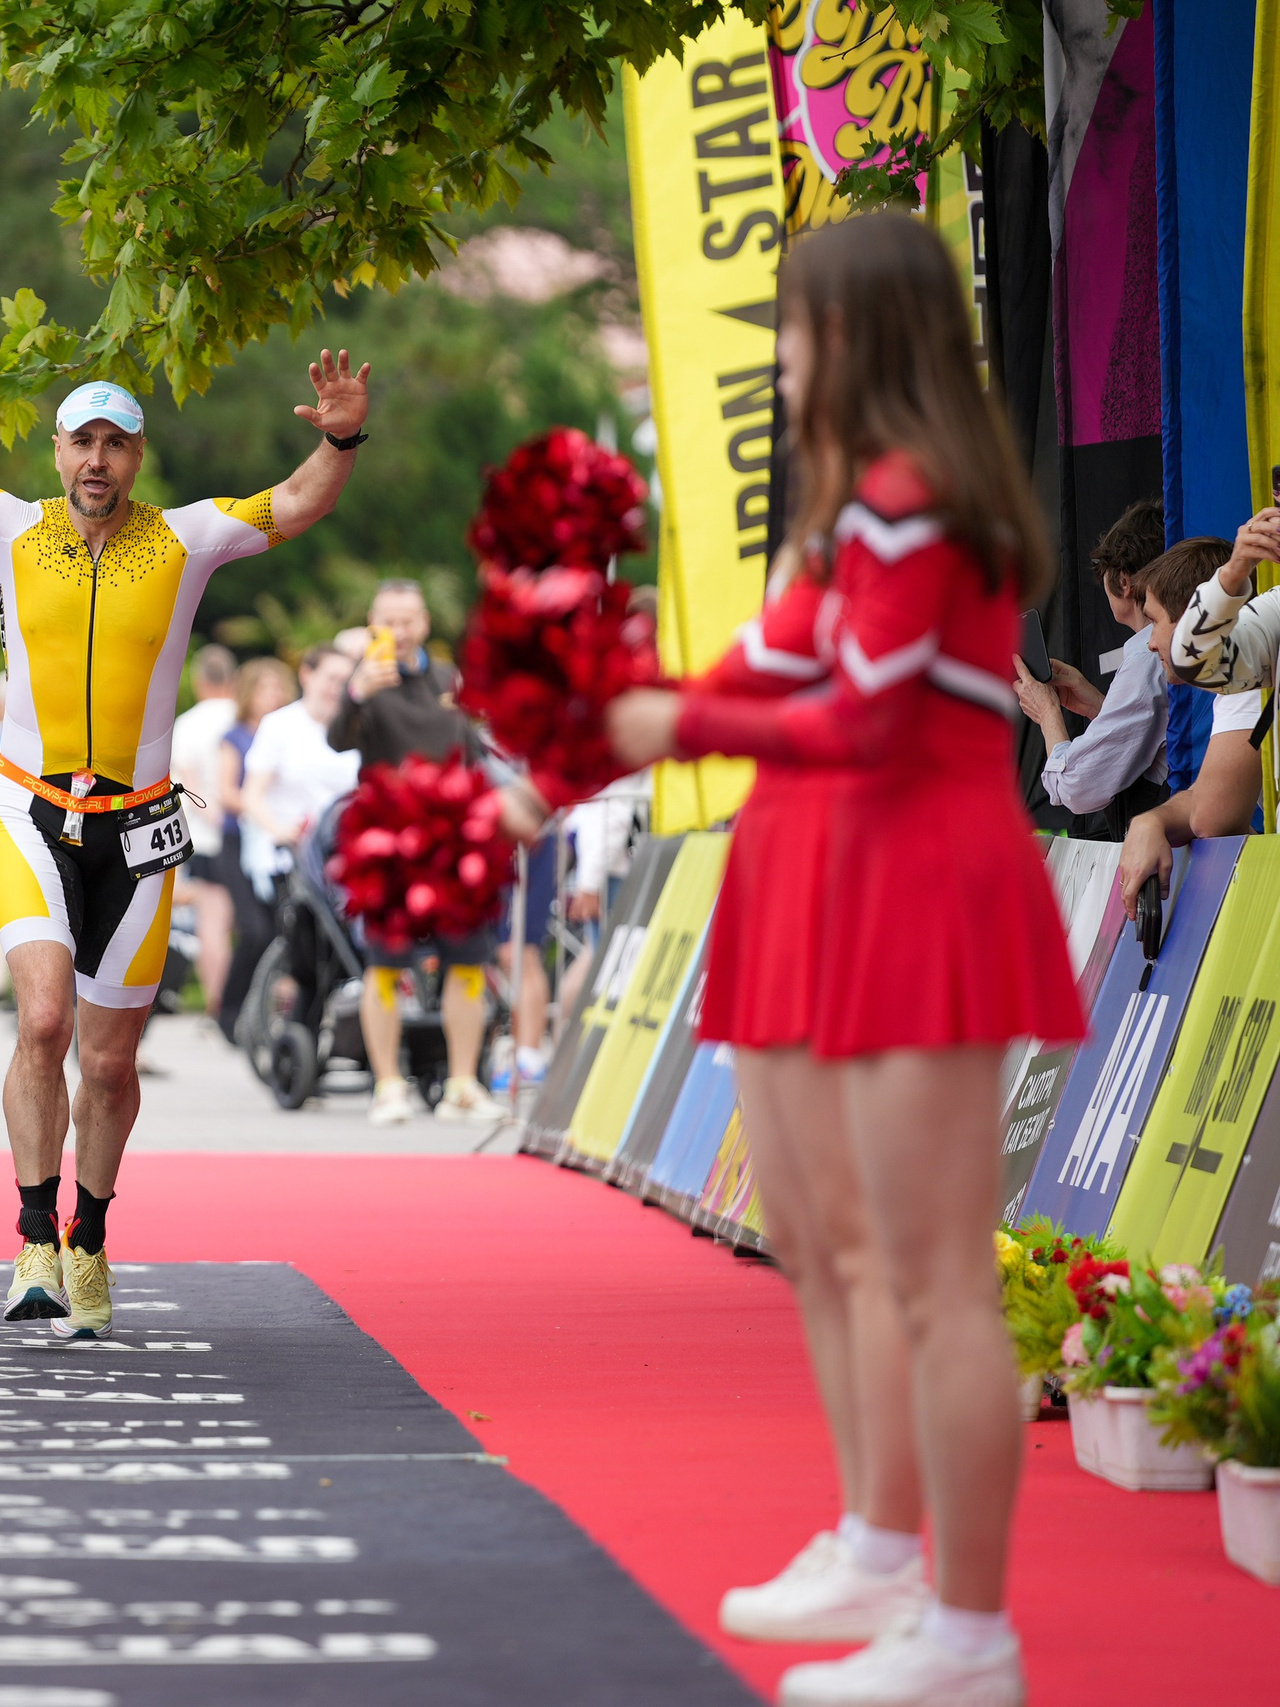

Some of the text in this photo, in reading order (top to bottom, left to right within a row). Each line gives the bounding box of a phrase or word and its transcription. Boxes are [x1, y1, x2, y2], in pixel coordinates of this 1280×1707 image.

[690, 51, 781, 261] STAR
[150, 819, 183, 852] 413
[1057, 992, 1170, 1194] AVA
